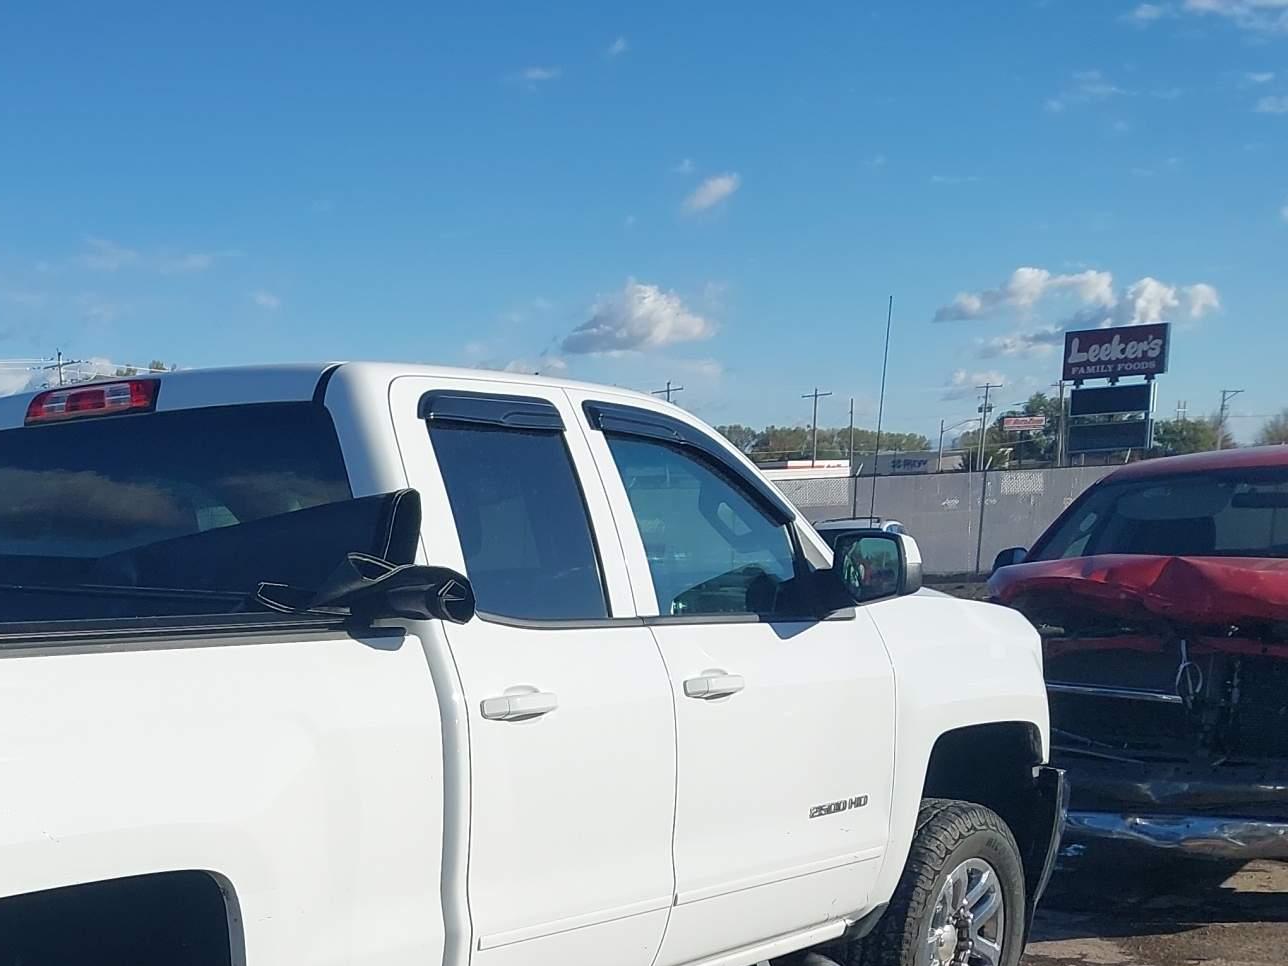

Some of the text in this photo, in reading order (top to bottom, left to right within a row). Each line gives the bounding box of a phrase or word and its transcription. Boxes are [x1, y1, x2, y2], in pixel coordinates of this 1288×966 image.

[1068, 334, 1163, 363] Leeker's
[1072, 361, 1156, 375] FAMILY FOODS
[809, 795, 868, 818] 2500 HD
